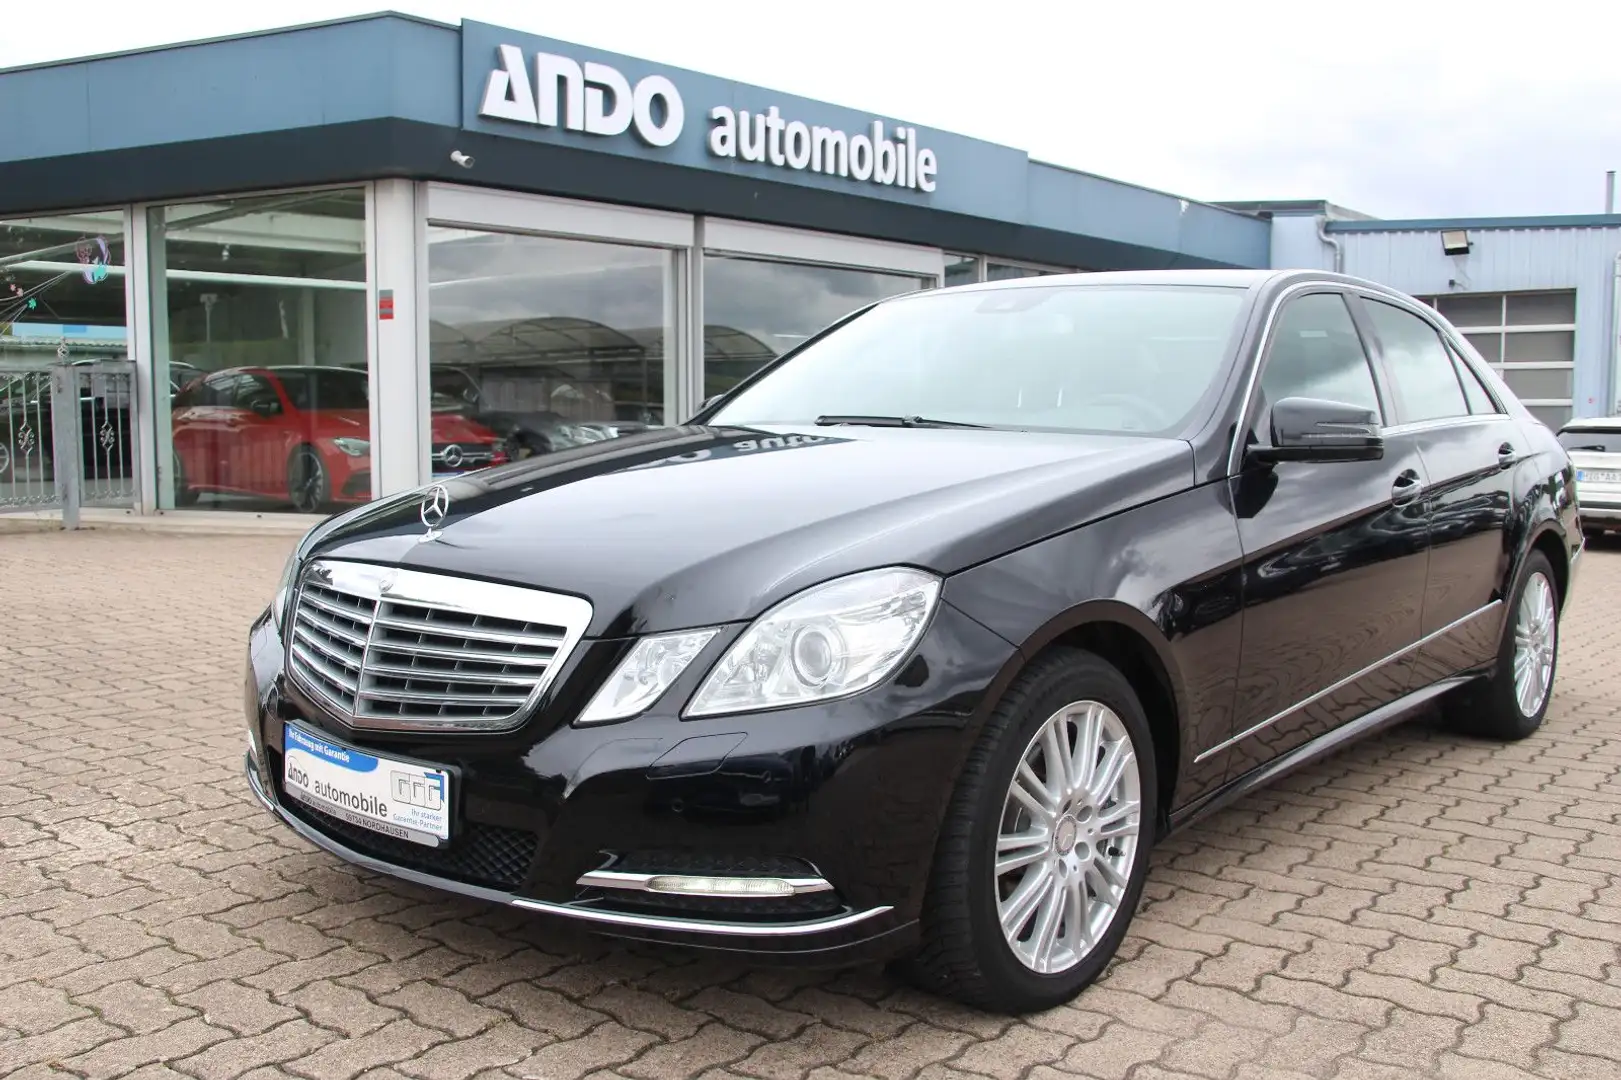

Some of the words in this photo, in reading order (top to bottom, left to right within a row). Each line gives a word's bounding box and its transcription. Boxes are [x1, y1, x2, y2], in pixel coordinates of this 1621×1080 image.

[478, 44, 684, 147] ANDO
[708, 106, 937, 192] automobile
[323, 745, 350, 763] Garantie
[314, 780, 388, 818] automobile
[420, 811, 442, 822] starker
[362, 818, 409, 839] NORDHAUSEN
